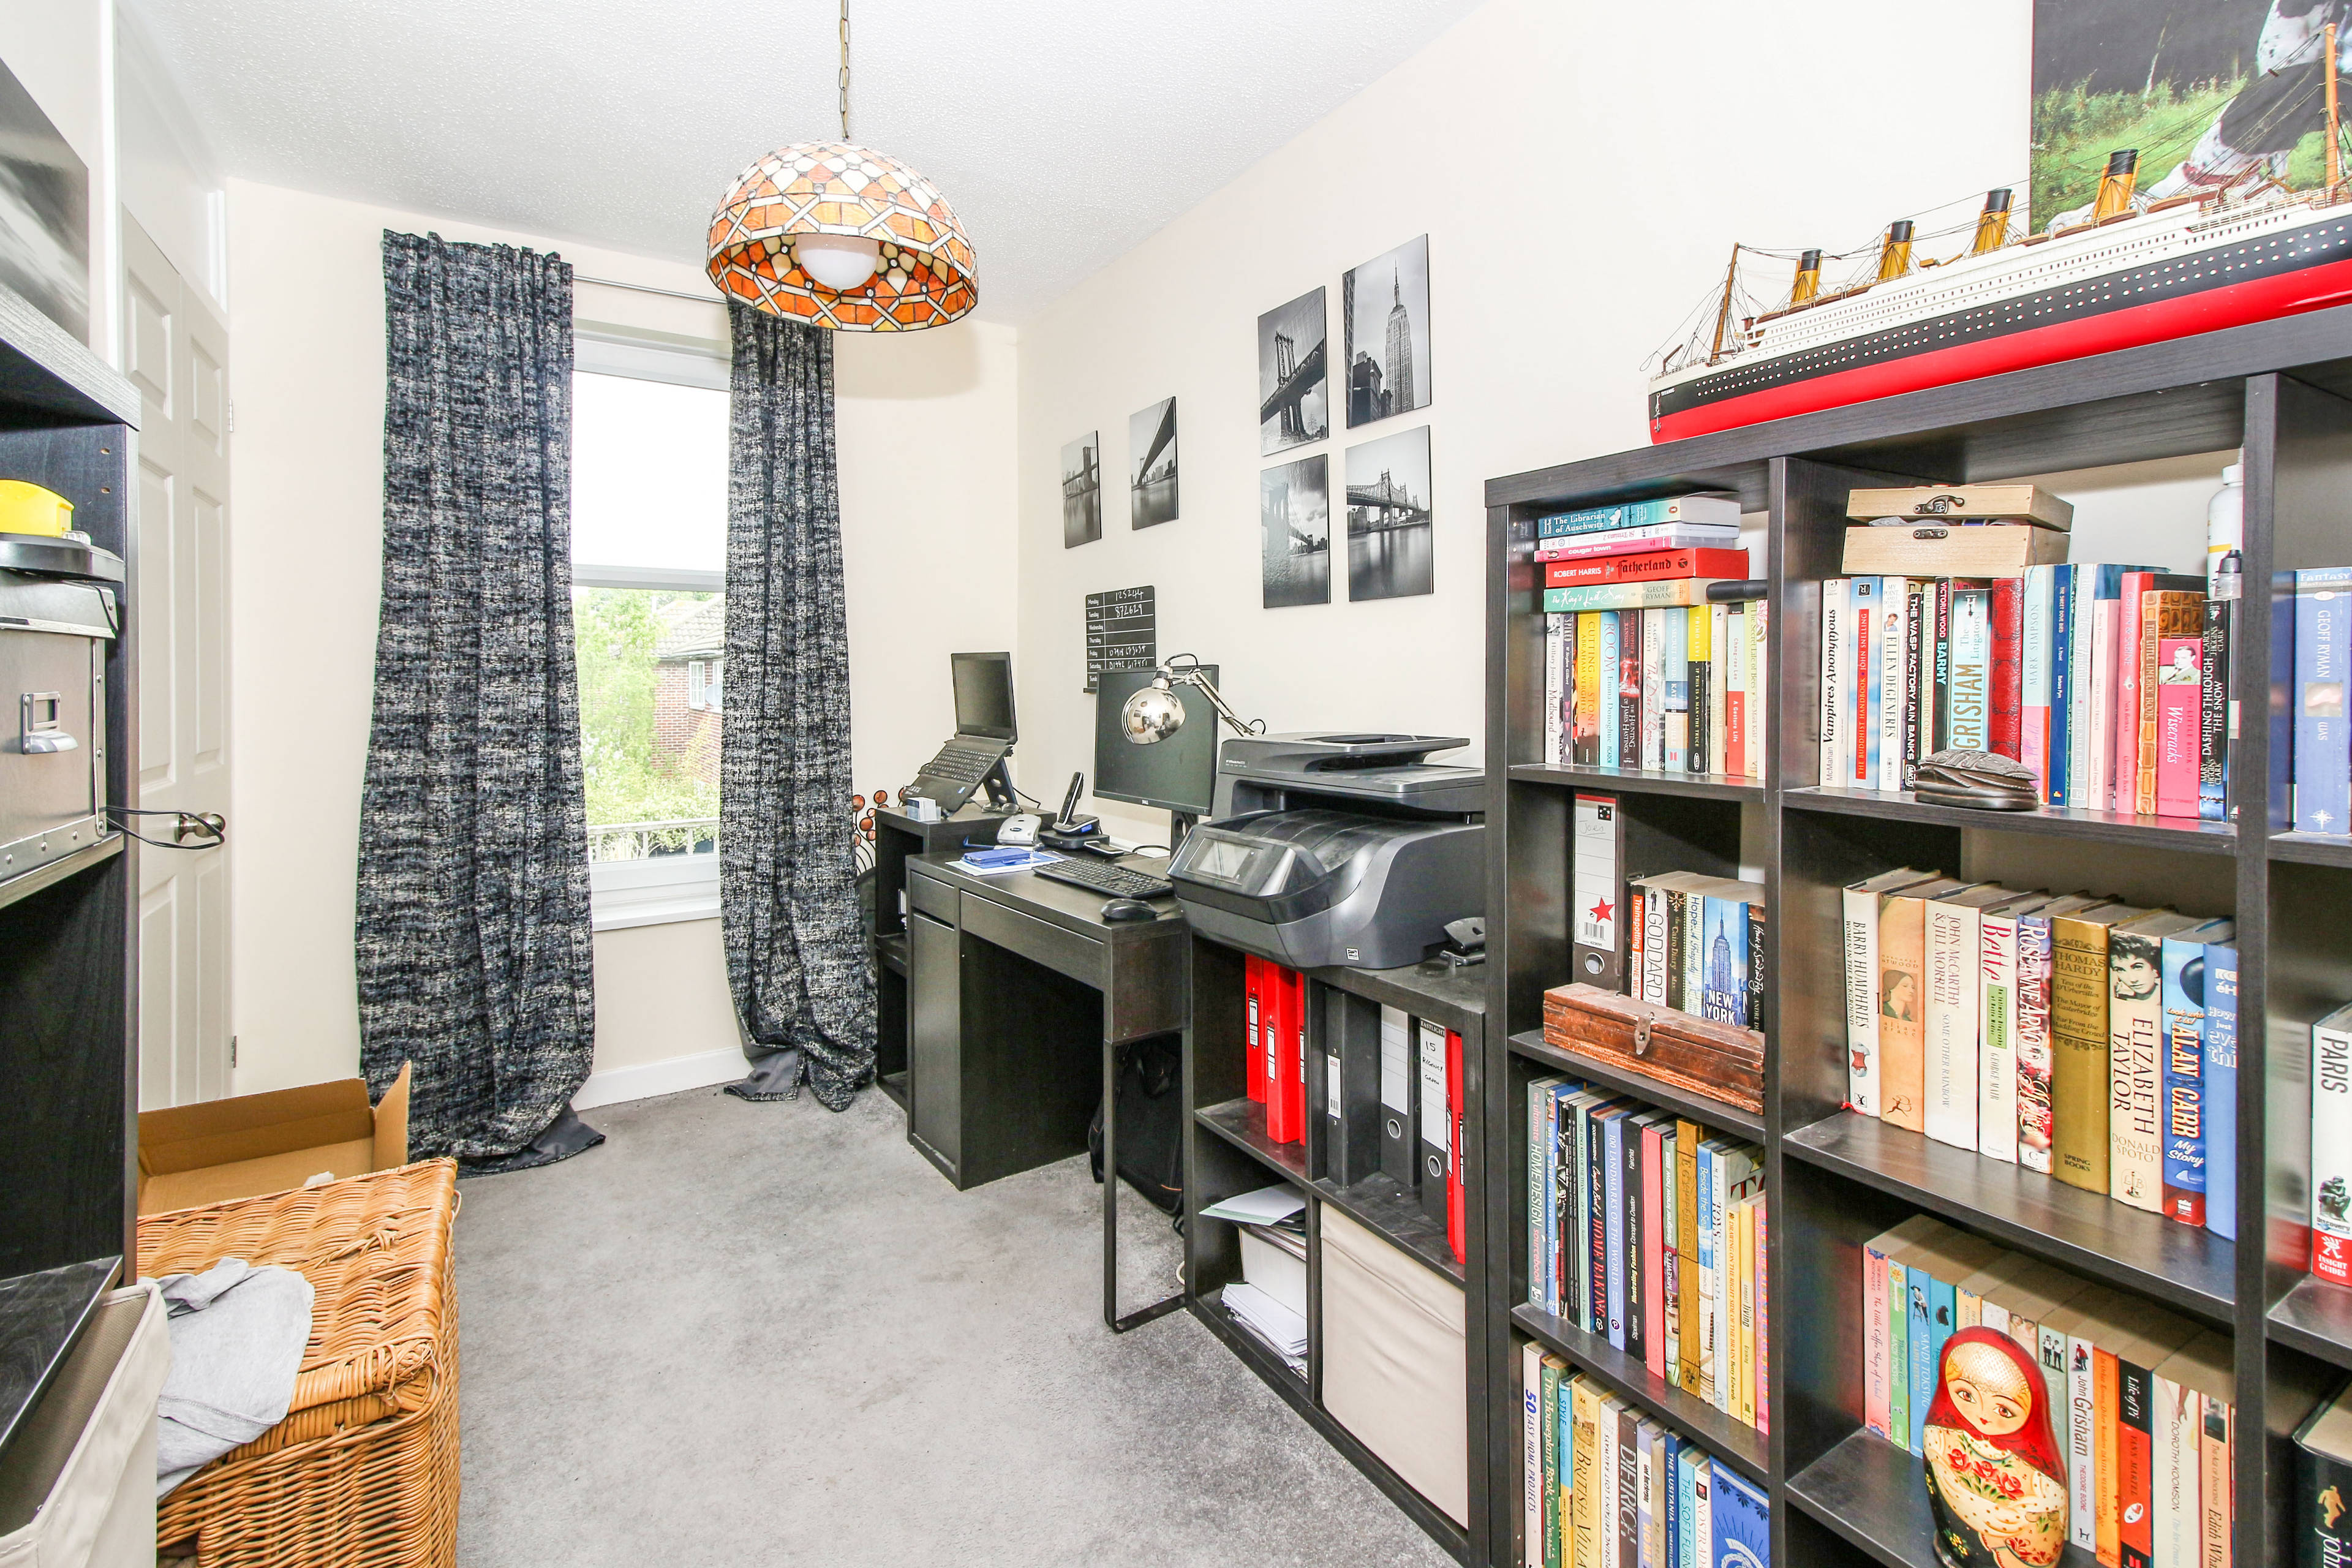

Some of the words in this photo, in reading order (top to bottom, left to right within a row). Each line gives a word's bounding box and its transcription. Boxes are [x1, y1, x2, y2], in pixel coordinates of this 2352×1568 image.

[1554, 516, 1568, 525] The
[1570, 512, 1605, 523] Librarian
[1565, 521, 1604, 532] Auschwitz
[1568, 545, 1593, 556] cougar
[1578, 567, 1601, 576] HARRIS
[1115, 589, 1144, 601] 125244
[1115, 603, 1143, 618] 872629
[1910, 597, 1918, 617] THE
[1909, 620, 1918, 650] WASP
[1959, 628, 1970, 647] The
[1970, 616, 1982, 659] Litigators
[2029, 603, 2039, 650] SIMPSON
[2146, 624, 2155, 636] THE
[2317, 610, 2331, 641] GEOFF
[1604, 623, 1616, 672] ROOM
[1825, 609, 1839, 684] Anonymous
[1886, 637, 1898, 671] ELLEN
[2145, 639, 2155, 660] LITTLE
[2316, 644, 2331, 678] RYMAN
[1908, 653, 1917, 698] FACTORY
[1936, 643, 1947, 685] BARMY
[2029, 656, 2038, 685] MARK
[2144, 663, 2155, 694] LIMERICK
[2203, 658, 2214, 707] THROUGH
[2214, 681, 2223, 705] SNOW
[1548, 690, 1558, 733] Mudbound
[1823, 685, 1837, 744] Vampires
[1885, 675, 1897, 738] DEGENERES
[1953, 664, 1983, 748] GRISHAM
[2144, 697, 2154, 719] BOOK
[2213, 709, 2223, 733] THE
[1907, 725, 1915, 760] BANKS
[2166, 706, 2184, 764] Wisecracks
[2202, 710, 2213, 755] DASHING
[1936, 913, 1946, 922] &
[1947, 915, 1961, 947] JOHN
[1853, 922, 1866, 956] BARRY
[1932, 922, 1946, 946] JILL
[1646, 913, 1664, 998] GODDARD
[1981, 924, 2012, 981] Bette
[2053, 951, 2106, 967] THOMAS
[2055, 960, 2101, 976] HARDY
[1934, 949, 1946, 1005] MORRELL
[1947, 949, 1959, 1009] McCARTHY
[1708, 990, 1733, 1009] NEW
[1853, 960, 1869, 1029] HUMPHRIES
[1704, 1004, 1735, 1026] YORK
[1942, 1013, 1950, 1037] SOME
[2167, 1006, 2187, 1017] Look
[1420, 1020, 1445, 1037] EASTLIGHT
[1426, 1041, 1436, 1052] 15
[2171, 1023, 2200, 1078] ALAN
[2113, 1031, 2131, 1111] TAYLOR
[2132, 1017, 2154, 1135] ELIZABETH
[2321, 1036, 2348, 1093] PARIS
[1941, 1069, 1950, 1107] RAINBOW
[1532, 1104, 1542, 1140] ultimate
[2171, 1087, 2200, 1139] CARR
[1547, 1126, 1553, 1139] on
[1608, 1134, 1617, 1148] 100
[2112, 1133, 2161, 1155] DONALD
[2174, 1140, 2196, 1155] My
[1531, 1143, 1542, 1182] HOME
[2064, 1153, 2090, 1166] SPRING
[2064, 1159, 2090, 1171] BOOKS
[2116, 1145, 2153, 1163] SPOTO
[2167, 1150, 2204, 1168] Story
[1609, 1150, 1618, 1208] LANDMARKS
[1700, 1166, 1708, 1194] Beside
[1531, 1183, 1543, 1227] DESIGN
[1610, 1212, 1618, 1226] OF
[1610, 1229, 1619, 1247] THE
[1533, 1228, 1542, 1283] sourcebook
[1611, 1250, 1619, 1285] WORLD
[2318, 1254, 2347, 1270] INSIGHT
[2320, 1262, 2346, 1277] GUIDES
[1921, 1332, 1930, 1364] SANDI
[1544, 1376, 1553, 1398] The
[1921, 1366, 1931, 1408] TOKSVIG
[2077, 1376, 2088, 1397] John
[2127, 1375, 2139, 1395] Life
[1525, 1389, 1536, 1414] 50
[2124, 1396, 2139, 1407] of
[2127, 1406, 2140, 1419] Pi
[1543, 1400, 1554, 1462] Houseplant
[2073, 1397, 2093, 1457] Grisham
[1527, 1439, 1536, 1466] HOME
[1528, 1469, 1536, 1513] PROJECTS
[1545, 1464, 1554, 1495] Book
[1576, 1449, 1591, 1520] BRITISH
[1681, 1479, 1690, 1501] THE
[2171, 1465, 2179, 1512] KOOMSON
[1681, 1504, 1691, 1535] SOFT
[2208, 1508, 2222, 1540] Edith
